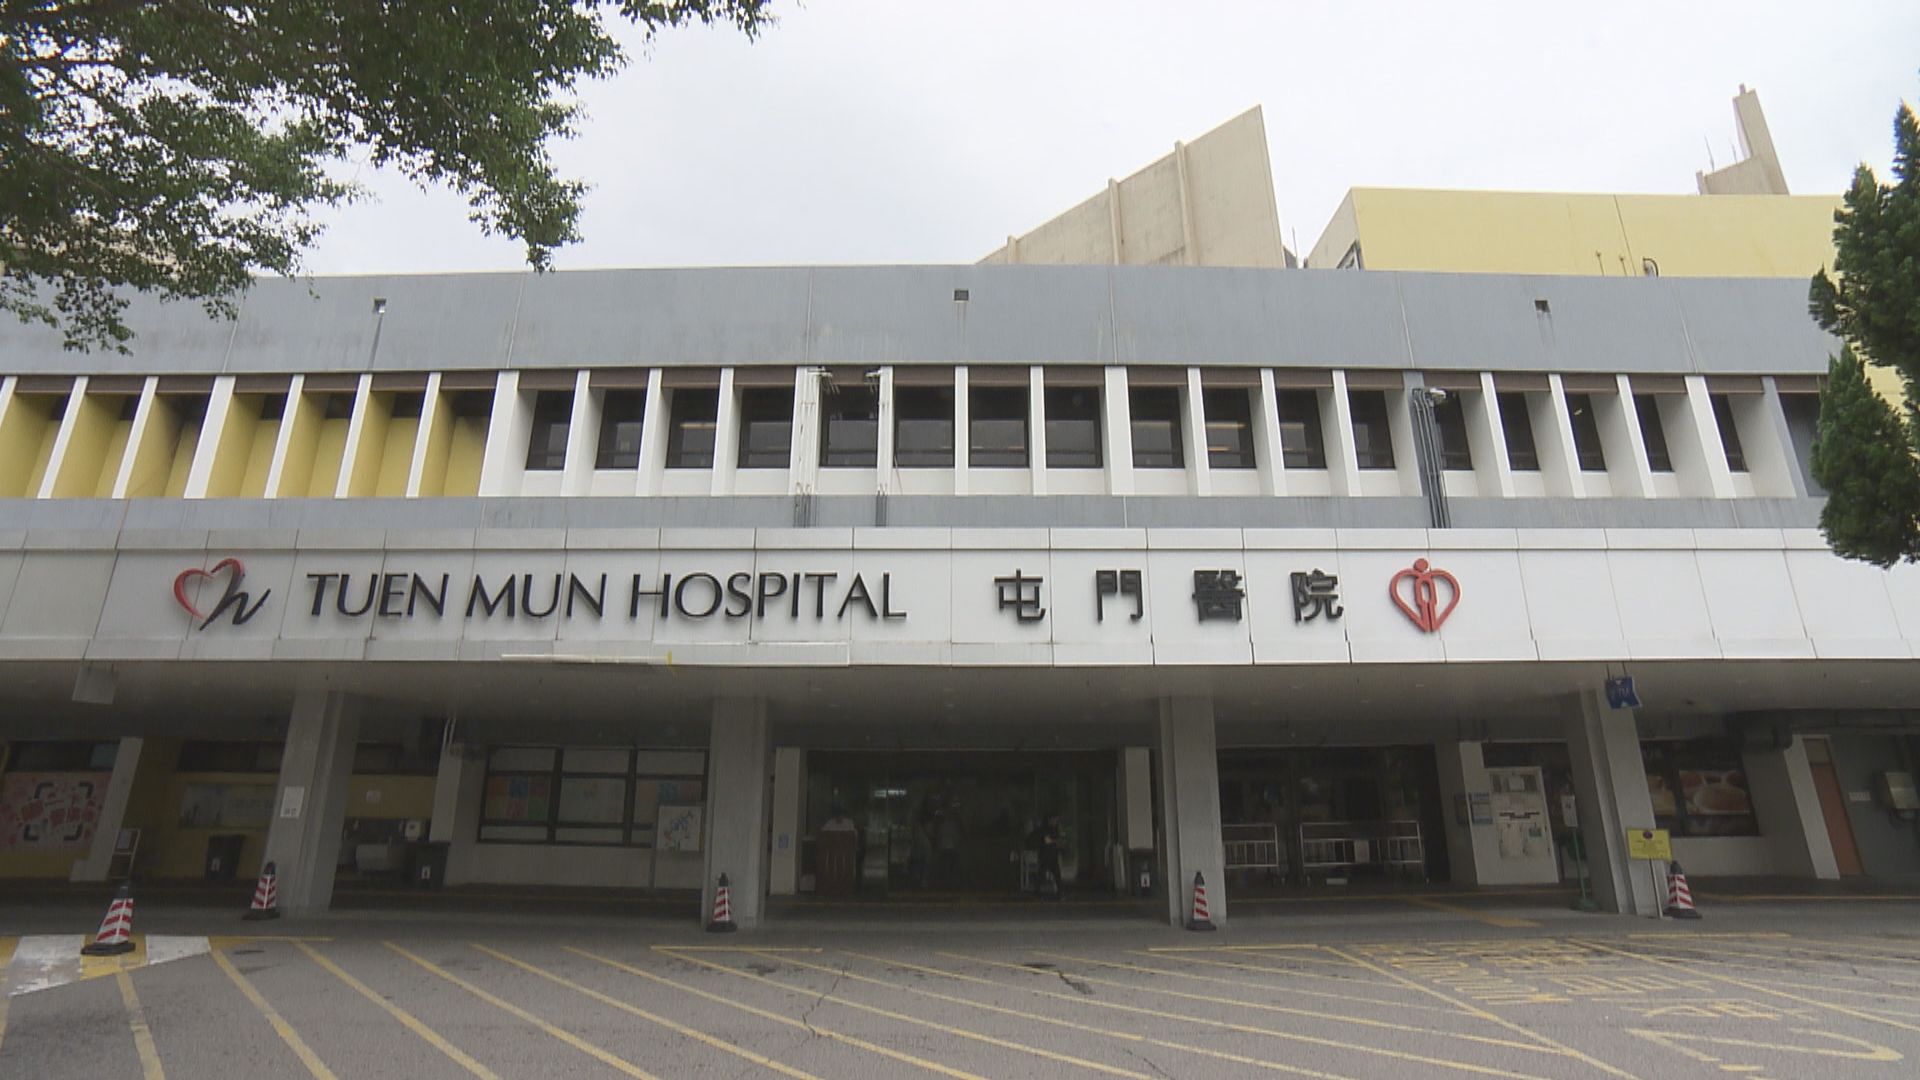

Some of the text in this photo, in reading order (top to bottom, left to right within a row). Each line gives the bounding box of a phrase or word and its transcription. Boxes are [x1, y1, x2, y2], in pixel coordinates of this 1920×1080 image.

[306, 571, 908, 620] TUEN MUN HOSPITAL
[993, 567, 1345, 625] 屯門醫院
